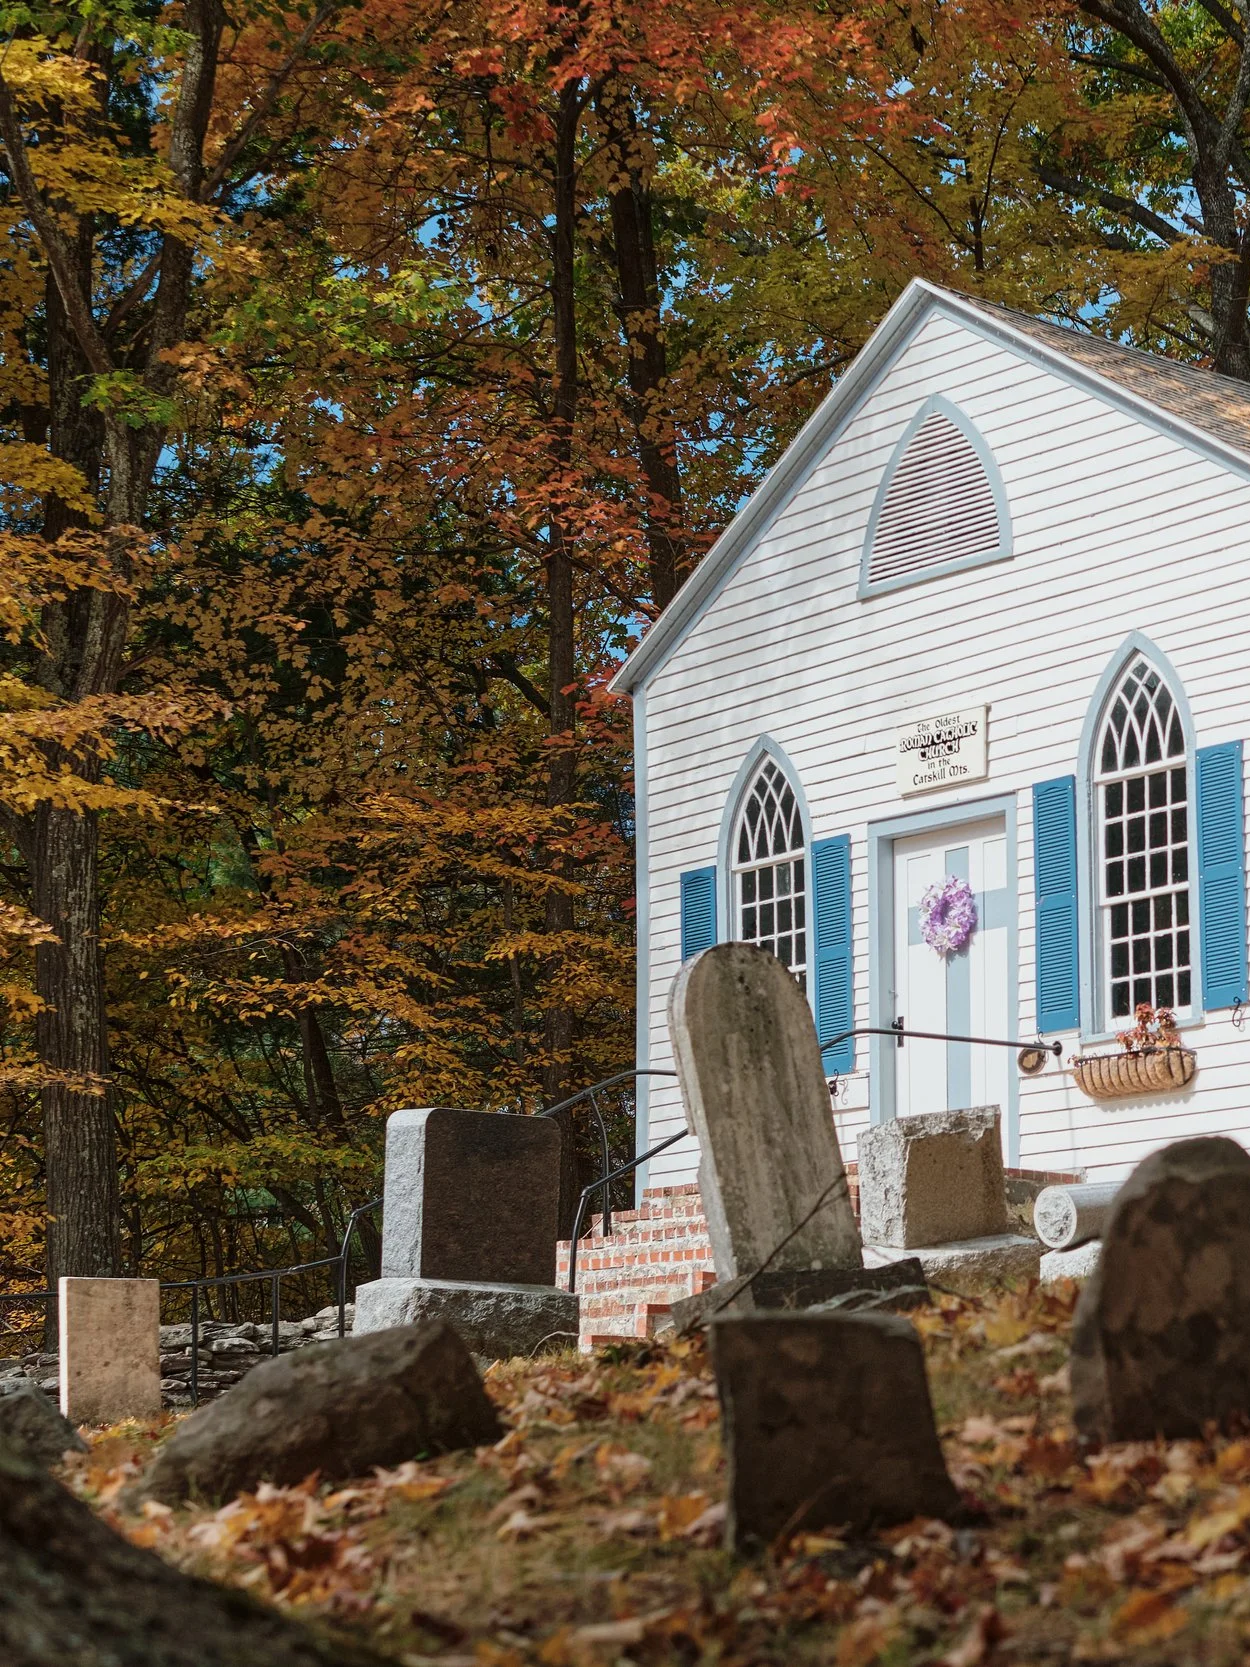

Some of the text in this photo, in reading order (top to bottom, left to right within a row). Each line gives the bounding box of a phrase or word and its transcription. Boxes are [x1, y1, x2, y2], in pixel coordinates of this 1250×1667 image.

[917, 715, 960, 733] The Oldest
[900, 721, 978, 753] ROMAN CATHOLIC
[918, 739, 960, 762] CHURCH
[927, 758, 950, 769] in the
[913, 765, 970, 786] Catskill Mts.
